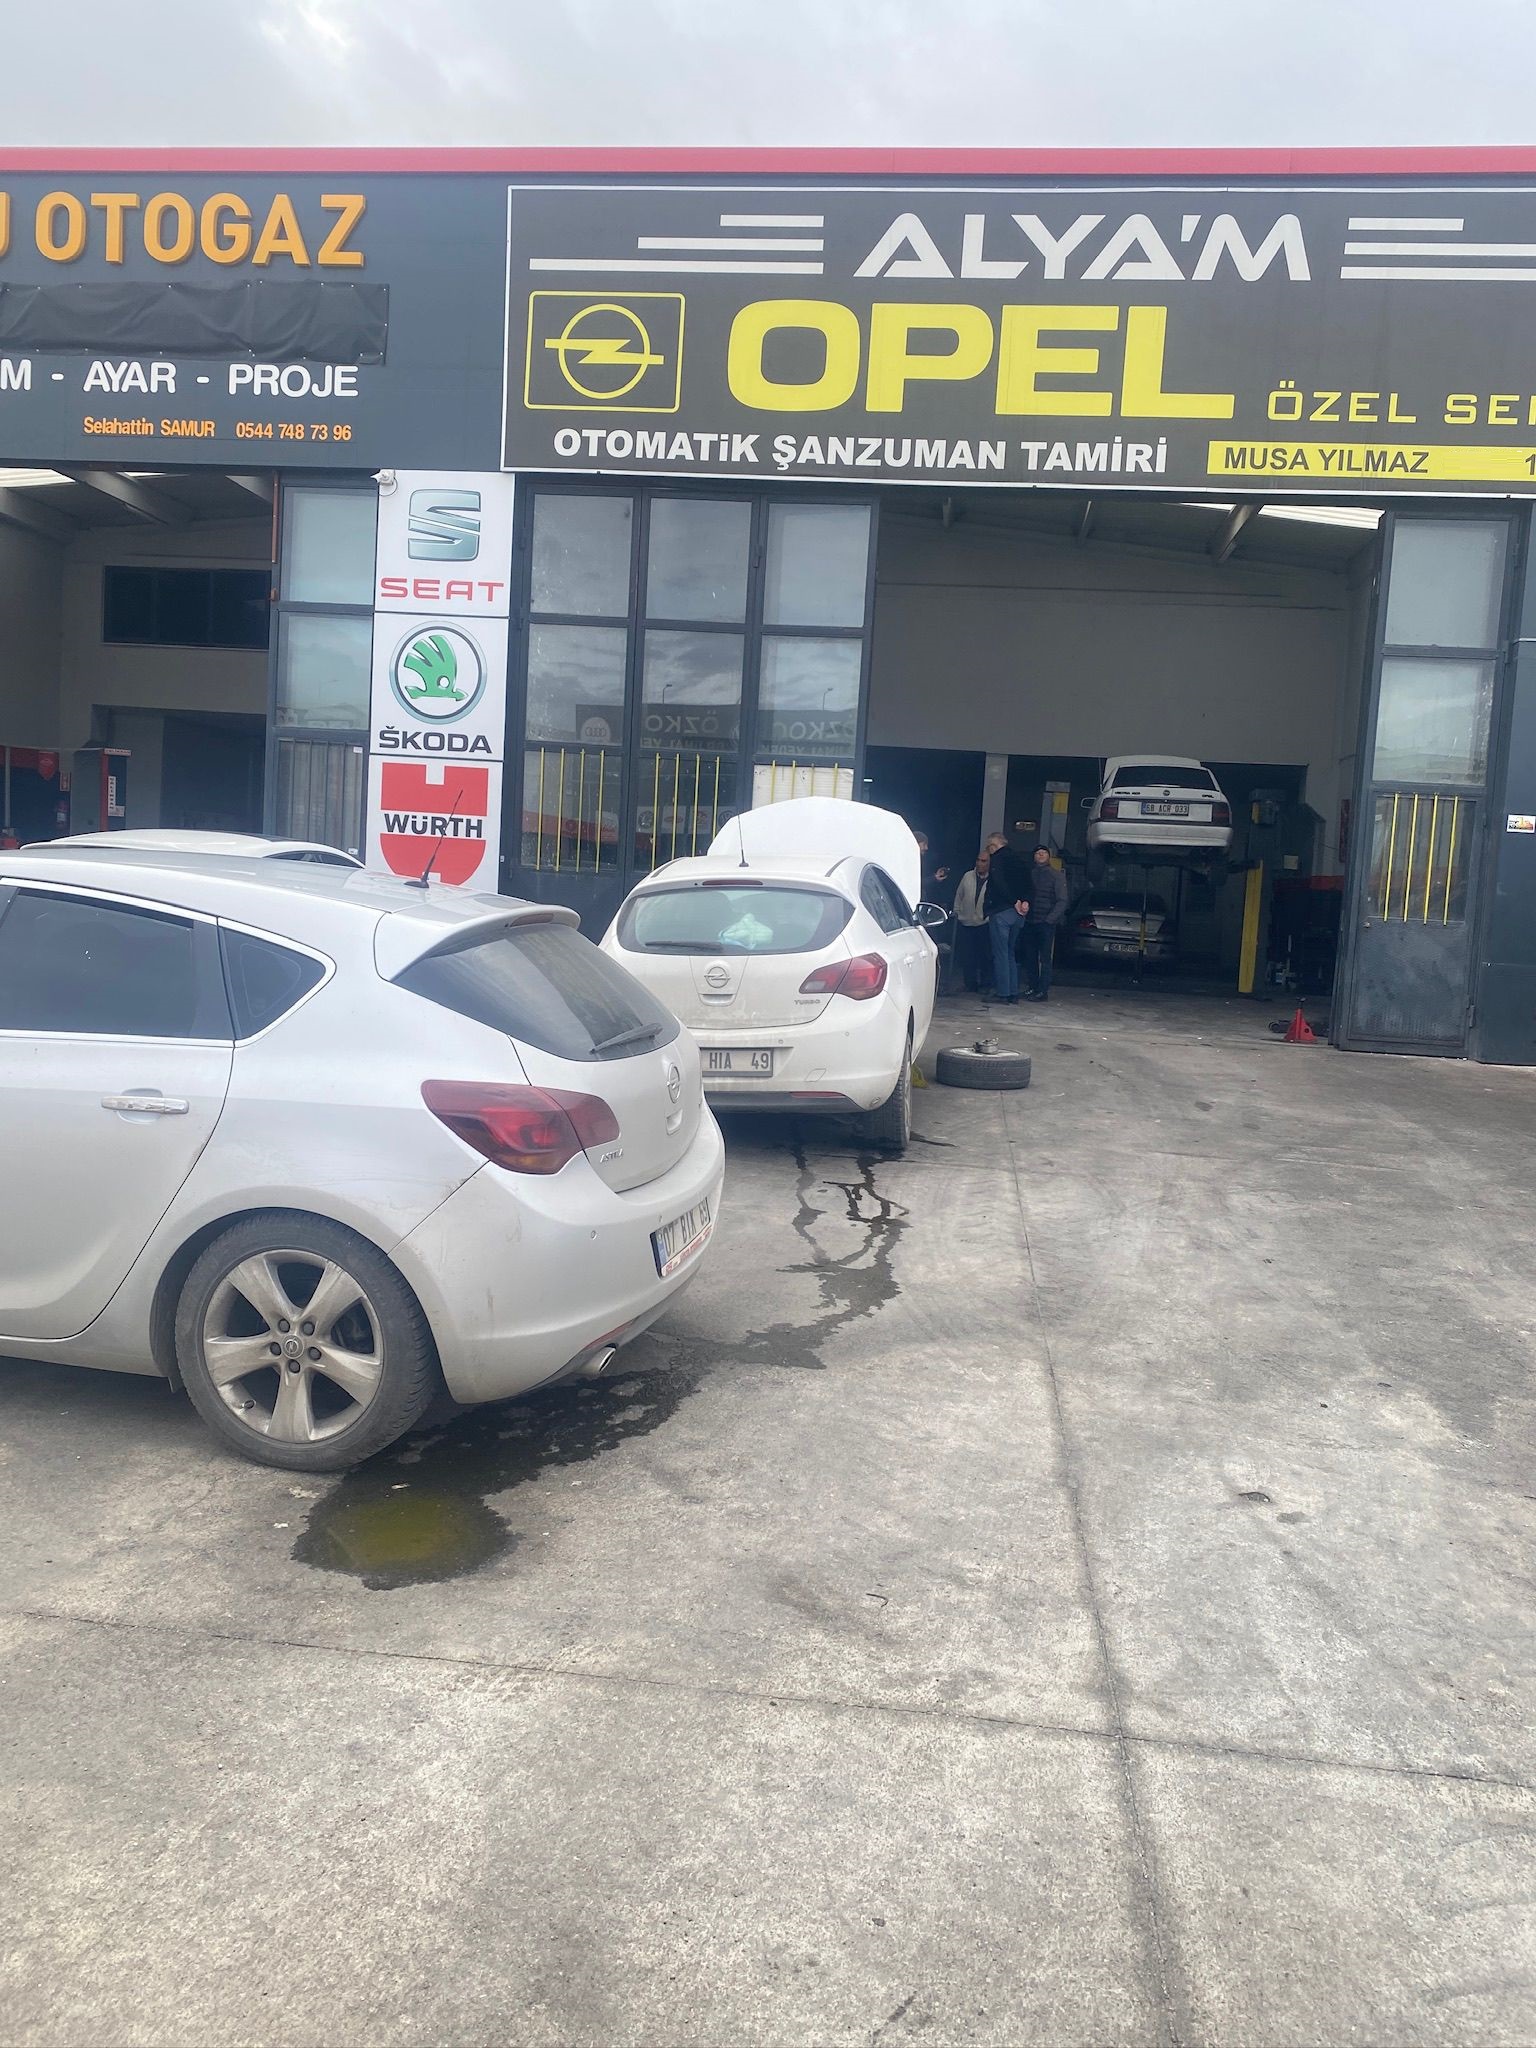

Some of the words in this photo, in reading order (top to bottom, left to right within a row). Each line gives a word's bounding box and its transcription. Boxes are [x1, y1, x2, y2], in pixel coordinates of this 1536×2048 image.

[35, 191, 367, 267] OTOGAZ
[853, 212, 1311, 282] ALYA'M
[727, 299, 1235, 419] OPEL
[83, 360, 176, 394] AYAR
[228, 364, 359, 398] PROJE
[1267, 380, 1417, 423] ÖZEL
[1444, 393, 1536, 425] SE
[83, 416, 154, 436] Selahattin
[160, 420, 215, 438] SAMUR
[235, 421, 274, 440] 0544
[278, 422, 305, 440] 748
[310, 423, 328, 441] 73
[332, 424, 352, 441] 96
[772, 434, 1006, 471] ŞANZUMAN
[1021, 436, 1168, 473] TAMİRİ
[1224, 447, 1310, 471] MUSA
[1318, 449, 1429, 474] YILMAZ
[380, 577, 505, 602] SEAT
[379, 726, 492, 754] ŠKODA
[709, 1053, 731, 1069] HIA
[751, 1053, 769, 1069] 49
